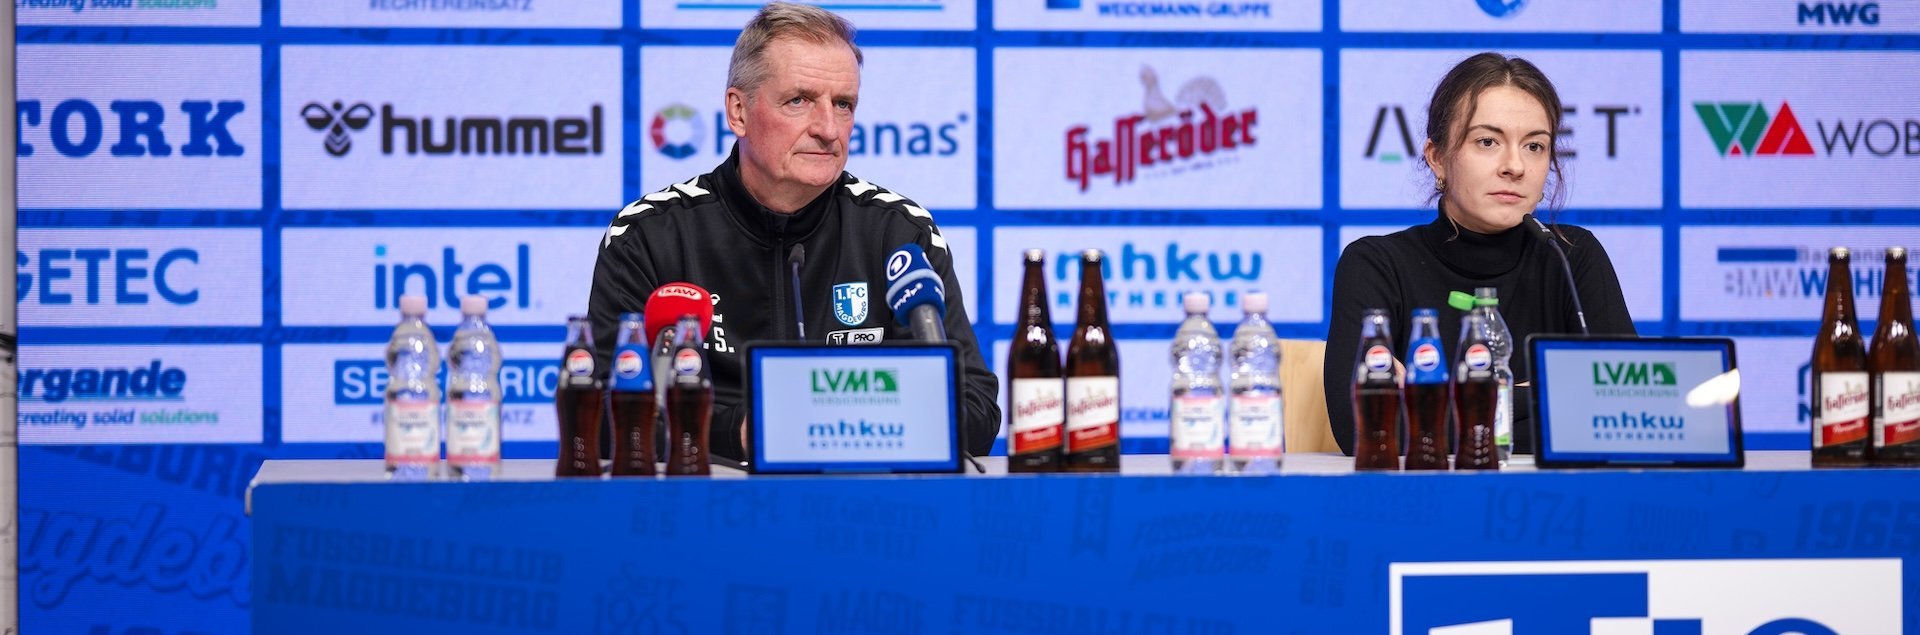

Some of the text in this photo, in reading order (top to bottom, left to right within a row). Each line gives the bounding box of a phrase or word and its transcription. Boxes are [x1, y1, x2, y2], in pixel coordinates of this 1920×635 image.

[1797, 2, 1881, 26] MWG
[381, 104, 604, 156] hummel
[374, 243, 530, 310] intel
[834, 301, 867, 324] MAGDEBURG
[853, 332, 876, 343] PRO
[18, 360, 187, 403] rgande
[811, 368, 868, 393] LVM
[1592, 361, 1650, 386] LVM
[92, 407, 136, 425] solid
[140, 408, 219, 426] solutions
[807, 418, 905, 437] mhkw
[1592, 410, 1685, 430] mhkw
[1480, 484, 1593, 552] 1974
[269, 521, 564, 585] FUSSBALLCLUB
[265, 561, 561, 631] MAGDEBURG
